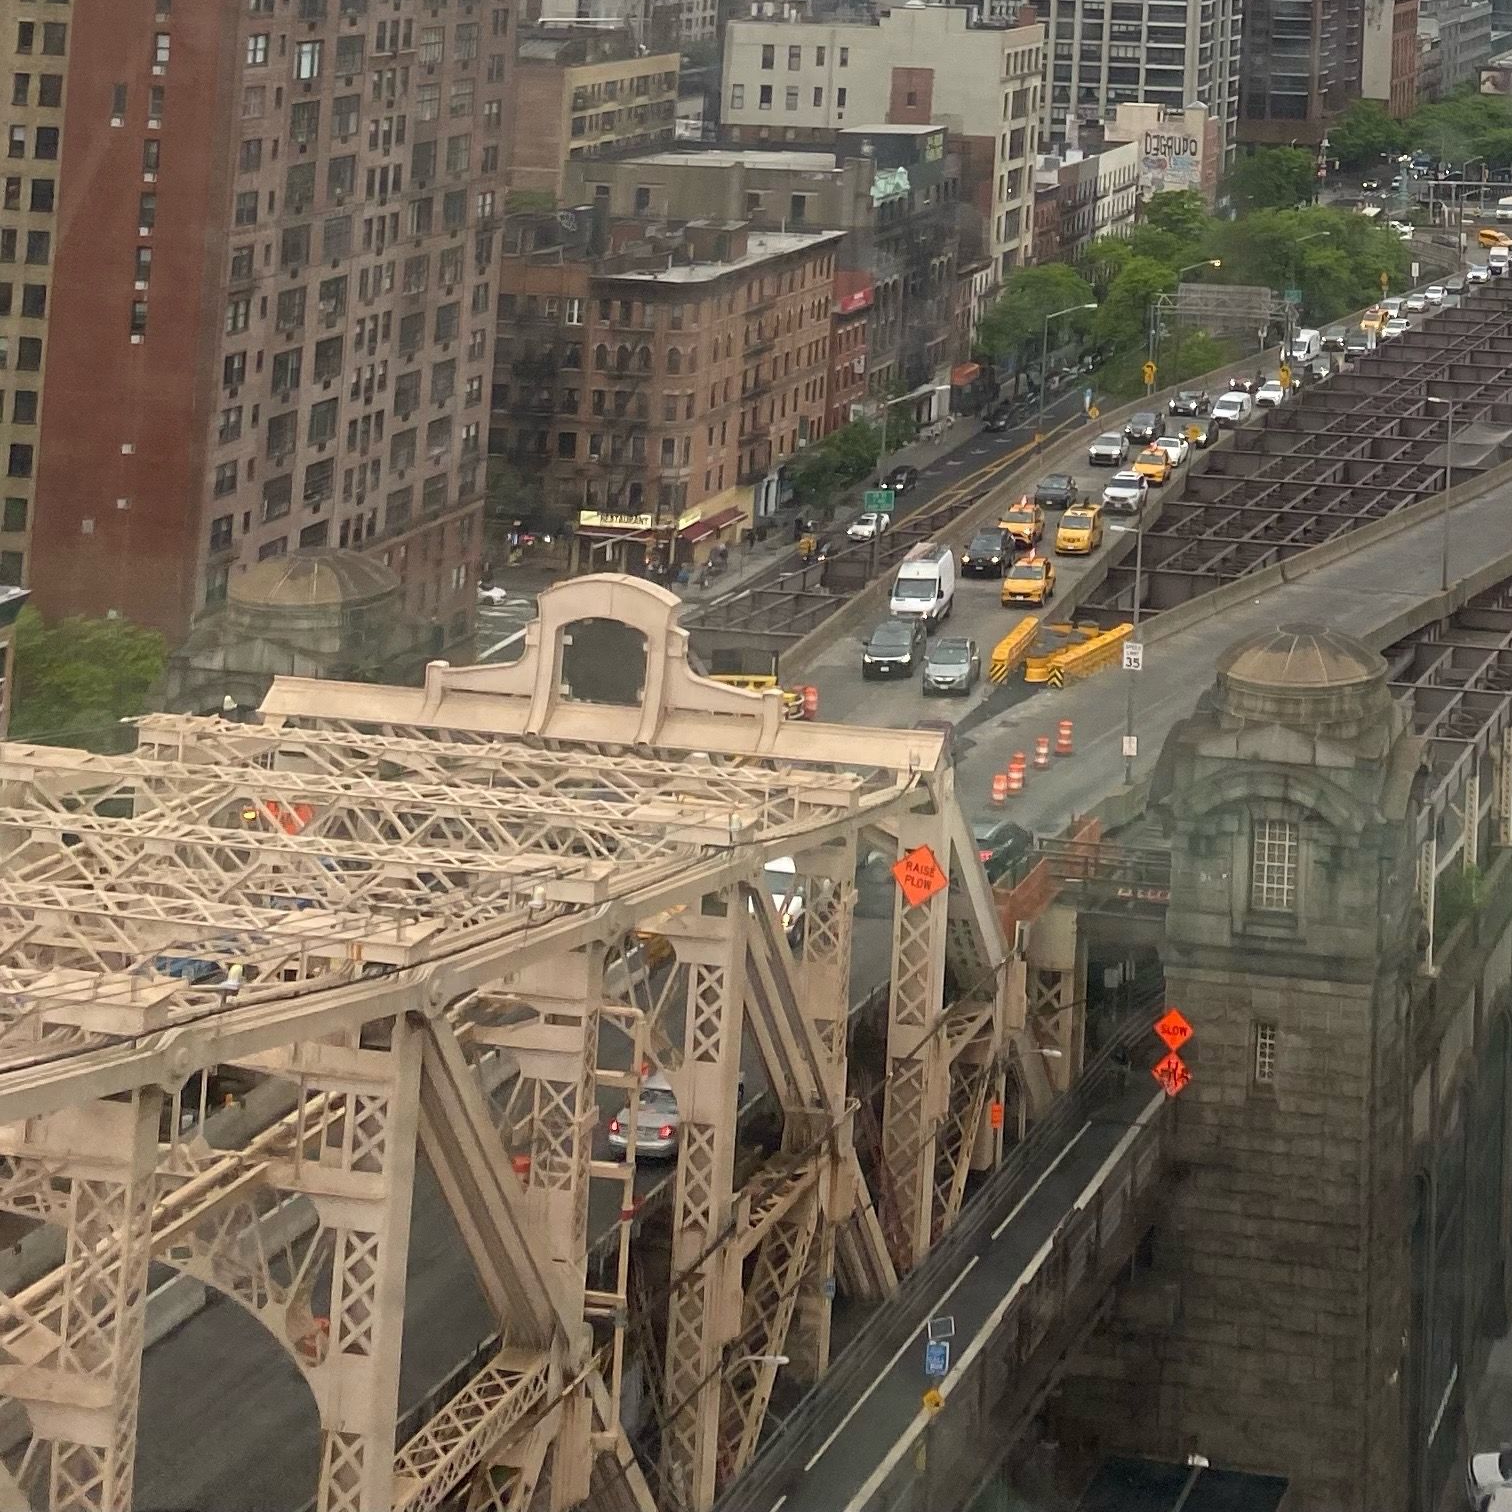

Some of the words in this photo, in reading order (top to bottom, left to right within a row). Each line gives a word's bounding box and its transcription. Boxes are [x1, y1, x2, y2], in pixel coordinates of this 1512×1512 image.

[1125, 656, 1140, 668] 35
[905, 860, 936, 879] RAISE
[905, 874, 932, 891] PLOW
[1160, 1024, 1188, 1037] SLOW
